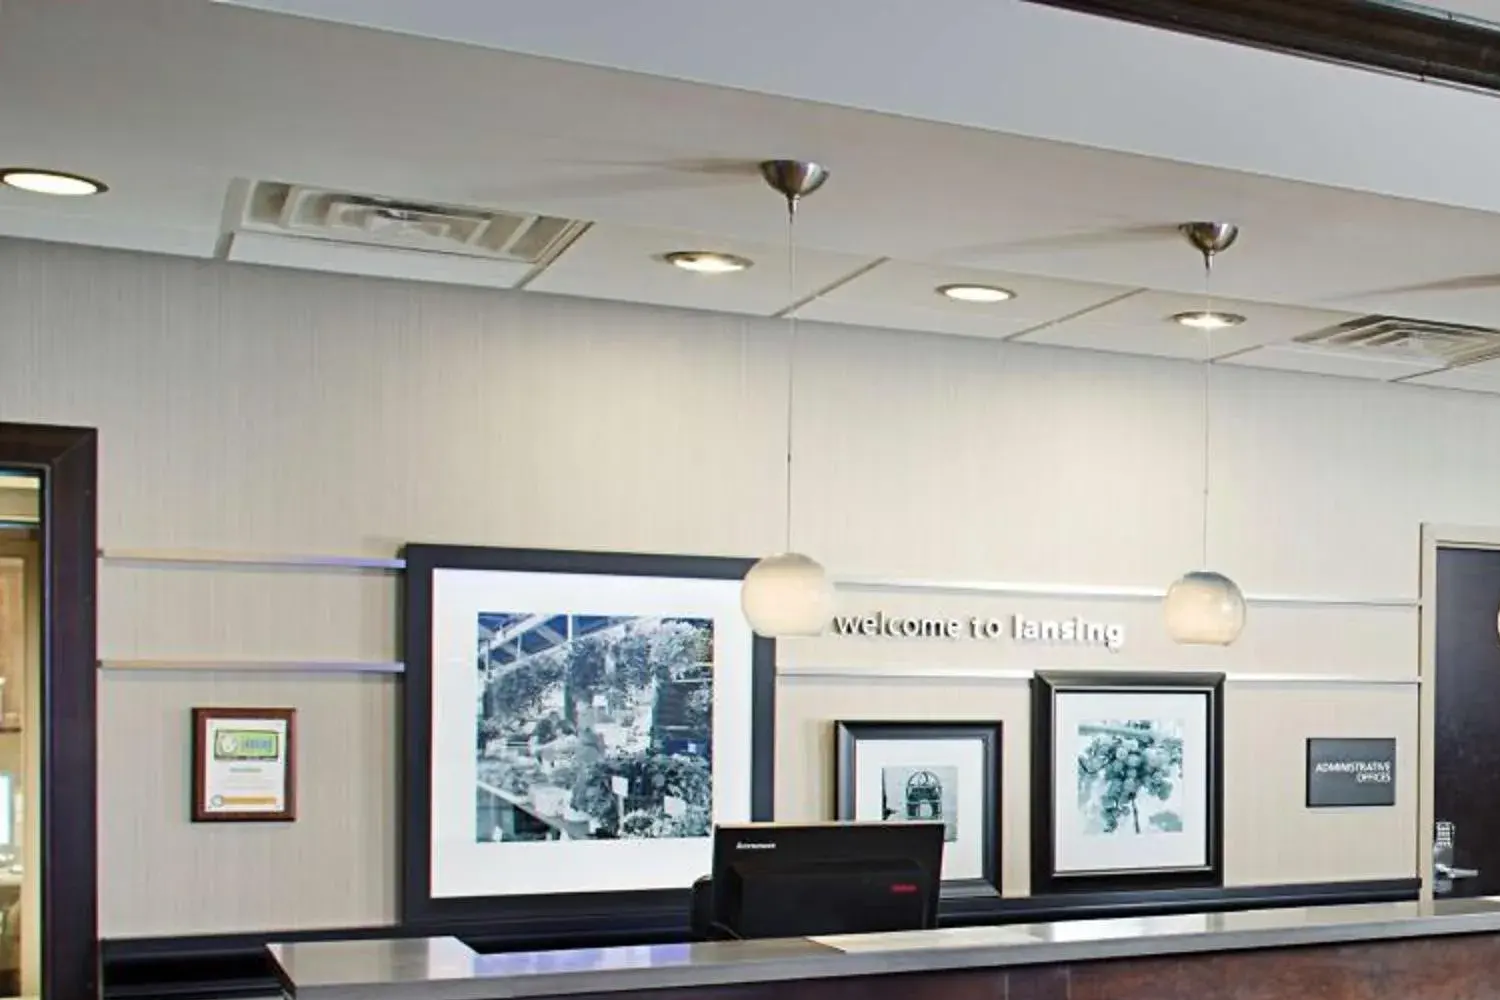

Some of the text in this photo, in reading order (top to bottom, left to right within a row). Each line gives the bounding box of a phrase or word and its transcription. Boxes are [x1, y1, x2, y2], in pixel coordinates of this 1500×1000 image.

[833, 611, 1124, 652] welcome to lansing
